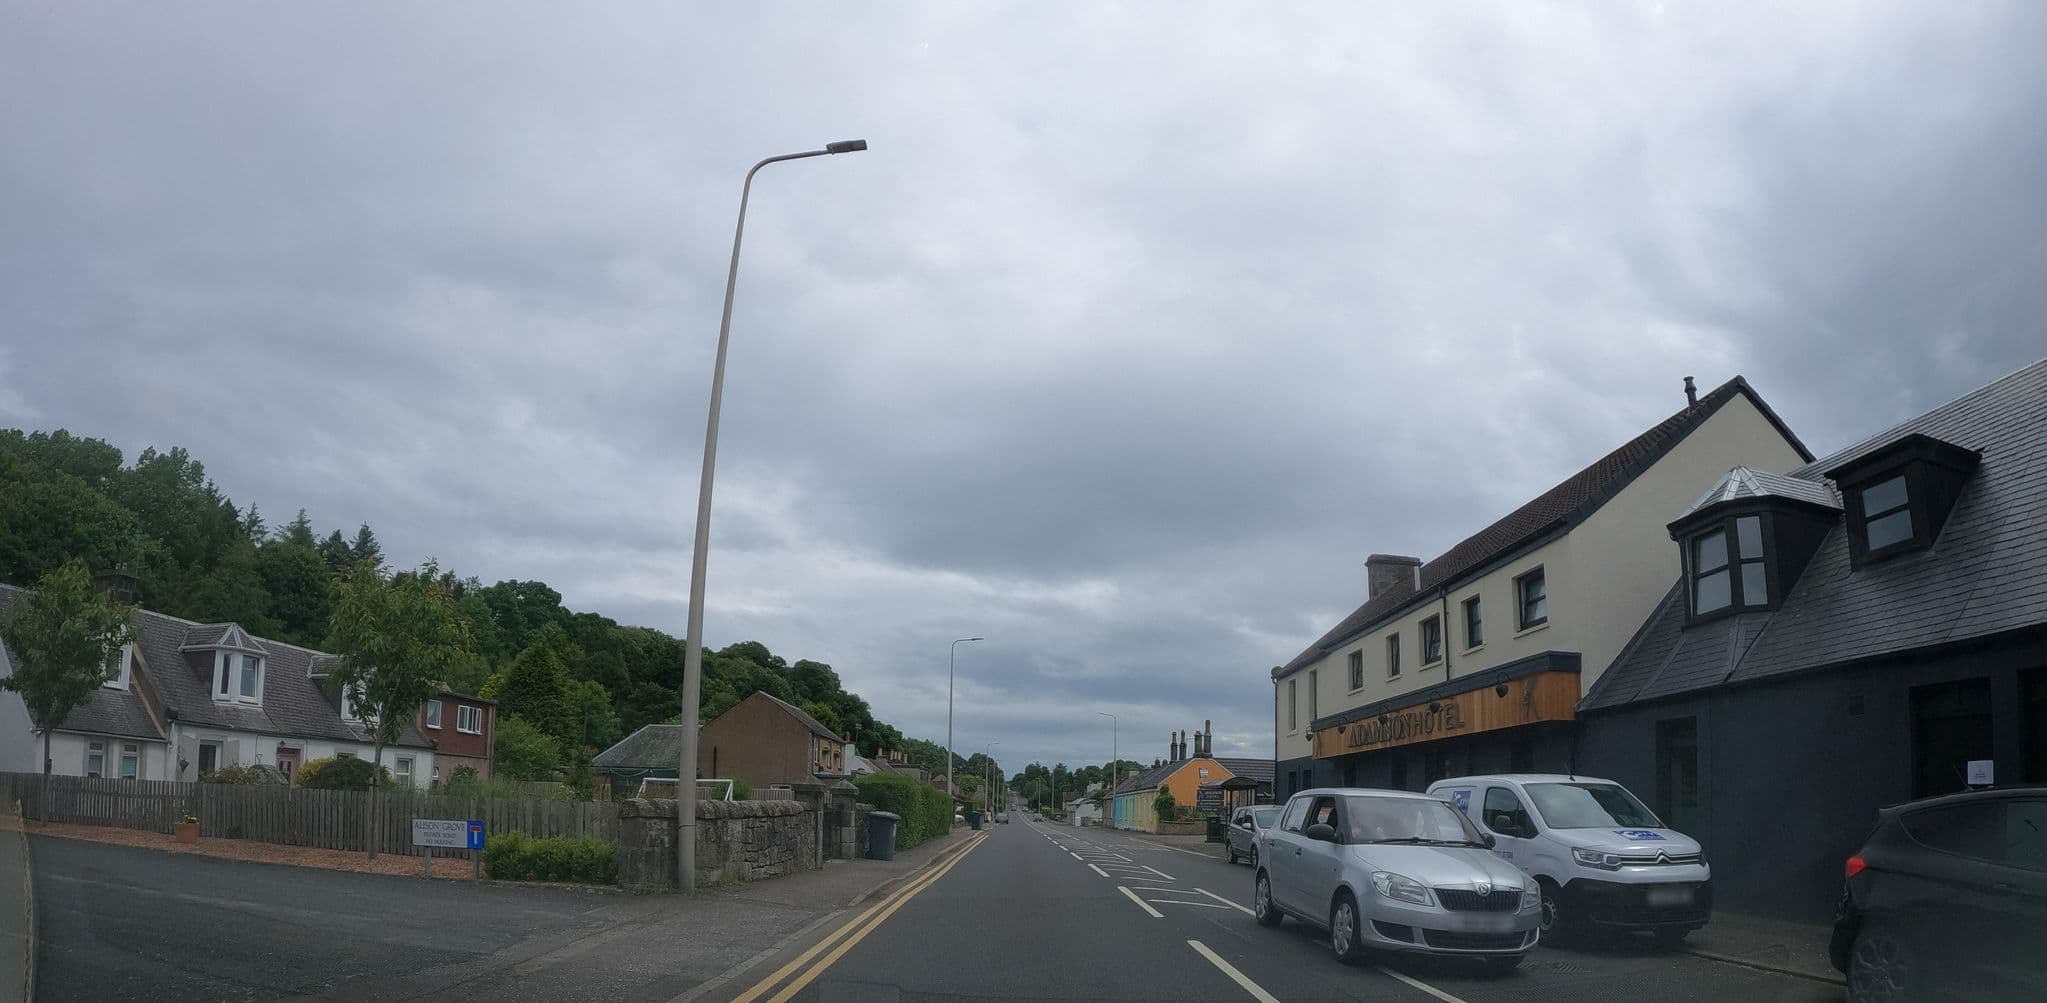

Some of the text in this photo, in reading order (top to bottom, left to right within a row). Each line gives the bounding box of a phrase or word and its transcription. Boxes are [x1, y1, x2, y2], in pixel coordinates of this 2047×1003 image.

[1349, 703, 1465, 746] ADAMSON HOTEL
[442, 823, 465, 831] GROVE
